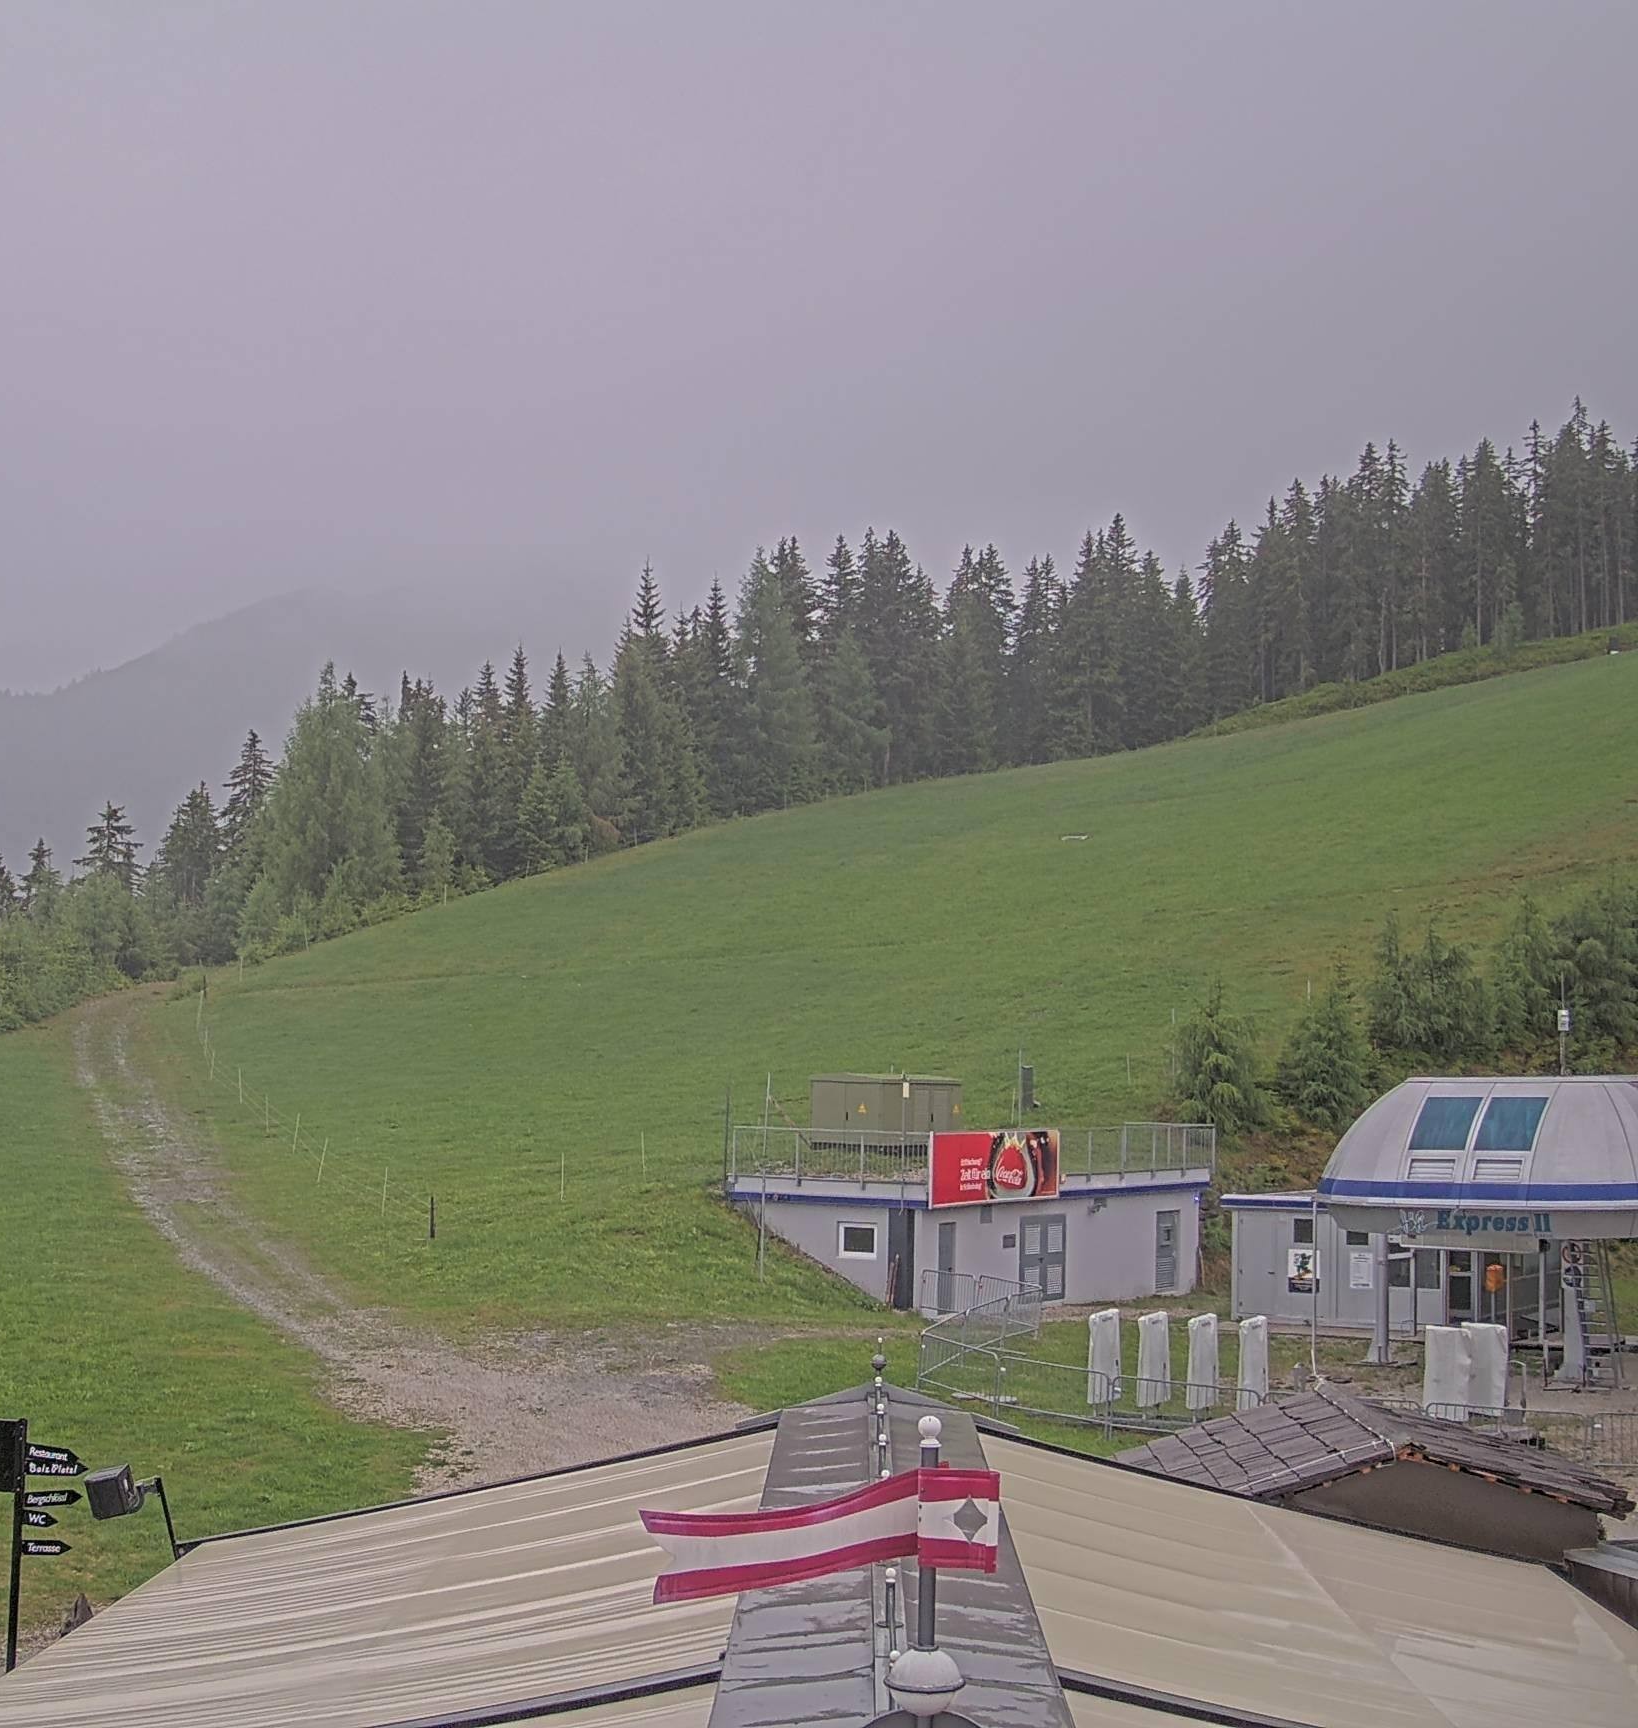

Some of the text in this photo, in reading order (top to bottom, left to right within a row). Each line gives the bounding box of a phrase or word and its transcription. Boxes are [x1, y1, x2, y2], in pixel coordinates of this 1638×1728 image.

[1436, 1210, 1529, 1235] Express
[29, 1446, 68, 1461] Restaurant
[28, 1513, 47, 1525] WC
[27, 1543, 62, 1553] Terrasse
